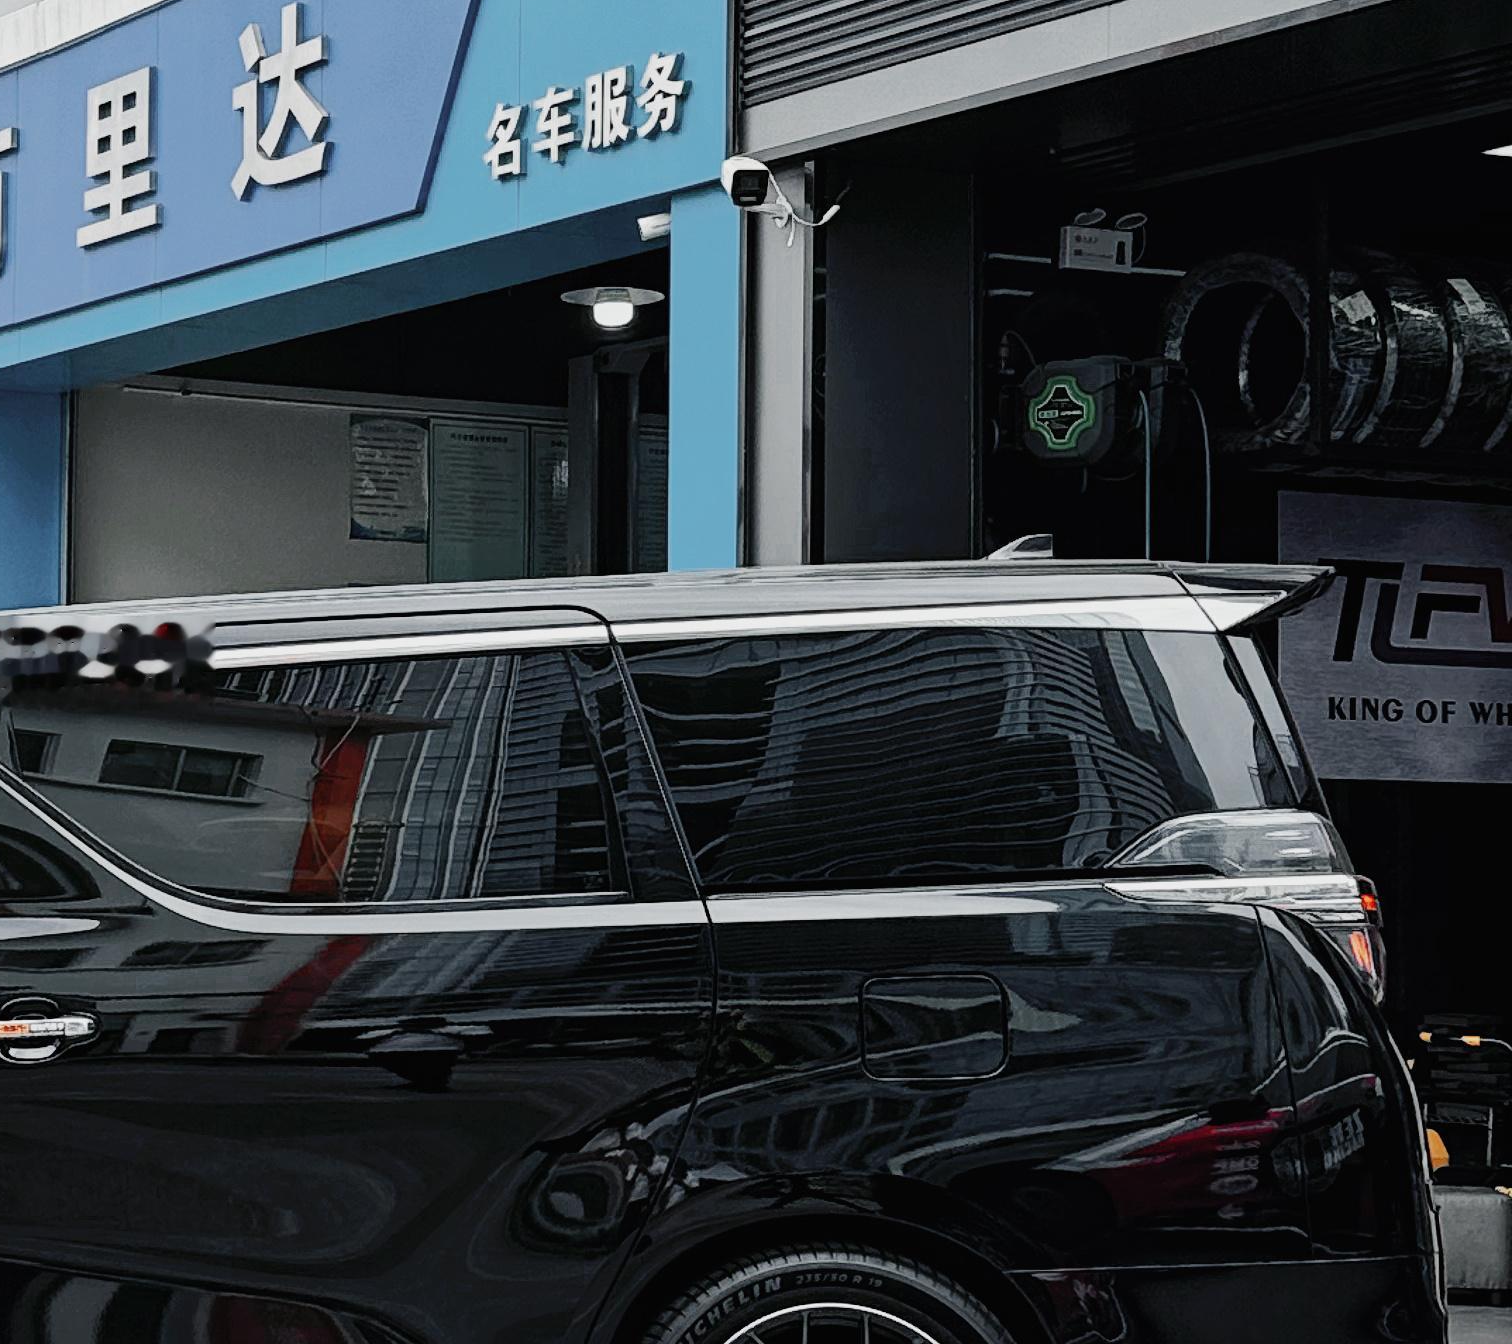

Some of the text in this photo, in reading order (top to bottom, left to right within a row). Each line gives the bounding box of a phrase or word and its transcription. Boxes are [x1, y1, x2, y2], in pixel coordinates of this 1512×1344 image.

[483, 51, 692, 182] 名车服务
[1327, 695, 1405, 723] KING
[1415, 699, 1457, 725] OF
